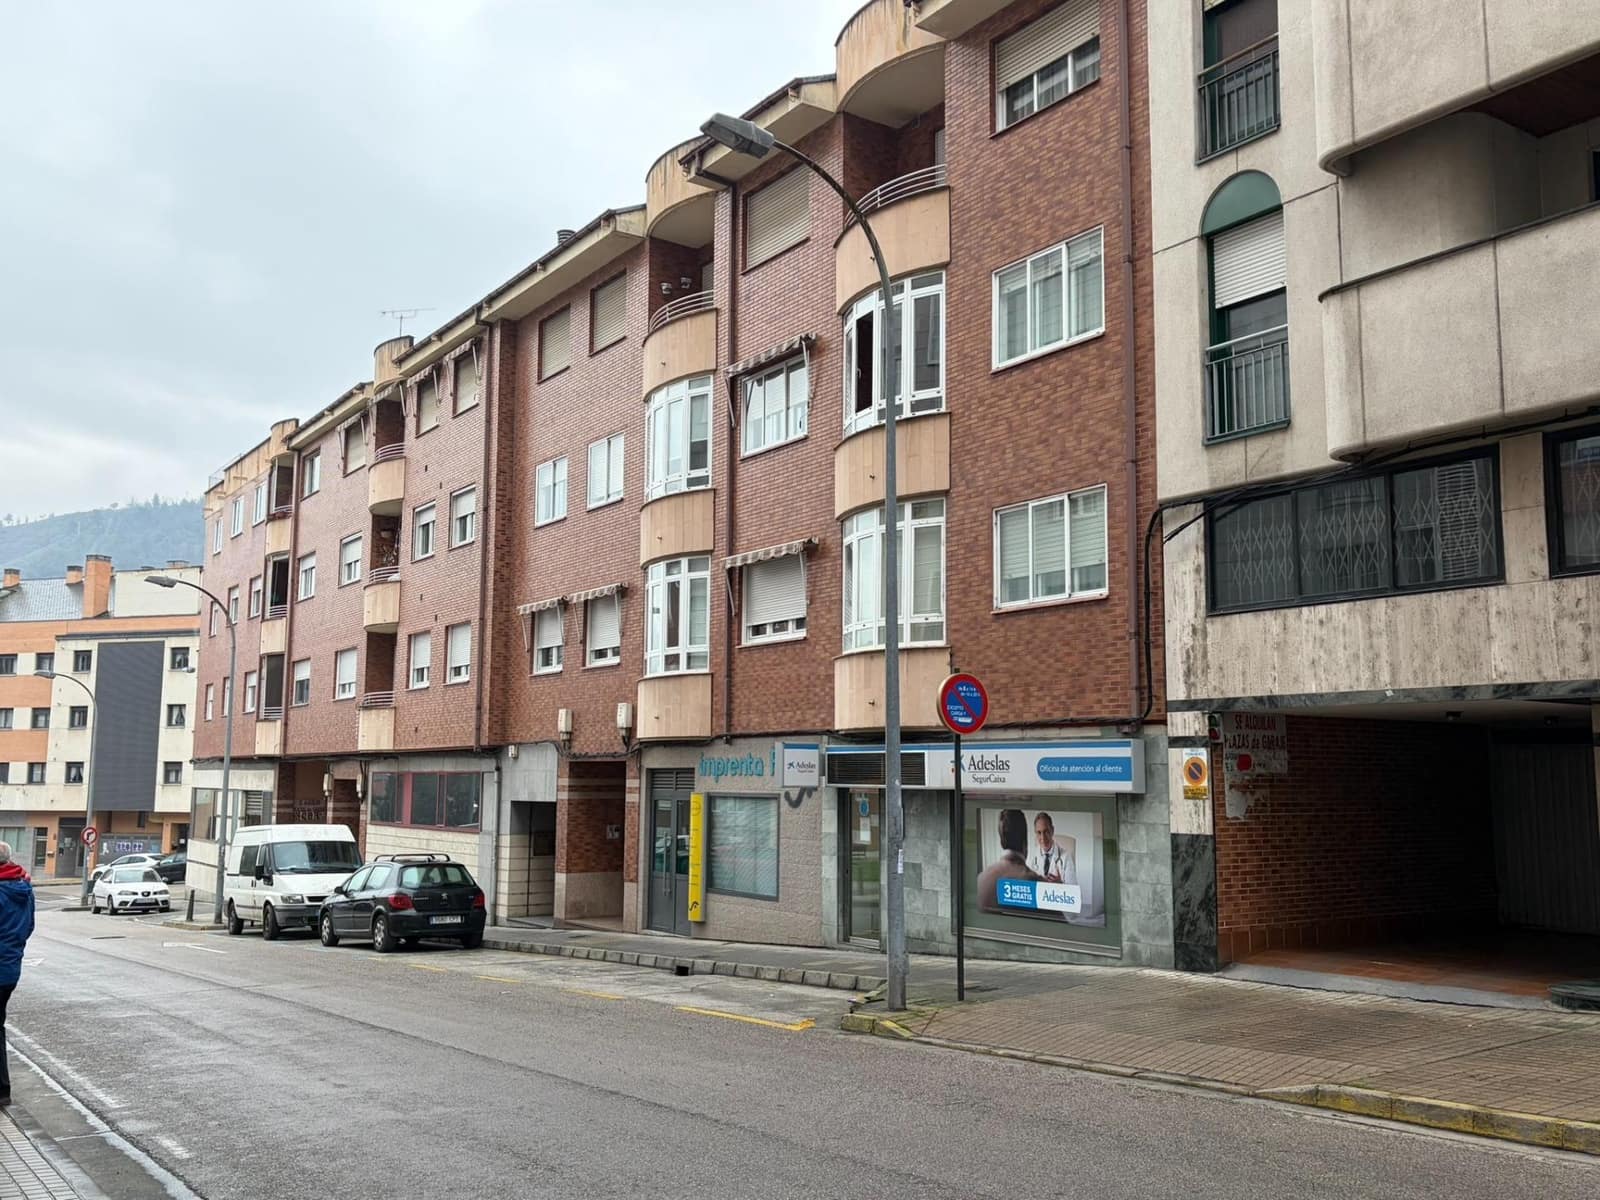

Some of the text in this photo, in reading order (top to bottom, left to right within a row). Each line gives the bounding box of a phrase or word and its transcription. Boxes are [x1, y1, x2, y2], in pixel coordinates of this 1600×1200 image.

[1235, 714, 1242, 729] SE
[1224, 734, 1250, 749] PLAZAS
[699, 752, 764, 783] imprenta
[968, 754, 1010, 771] Adeslas
[1040, 764, 1123, 773] Oficina de atención al cliente
[972, 773, 1006, 785] SegurCaixa
[1004, 884, 1031, 899] 3 MESES
[1012, 892, 1033, 901] GRATIS
[1042, 889, 1075, 905] Adeslas
